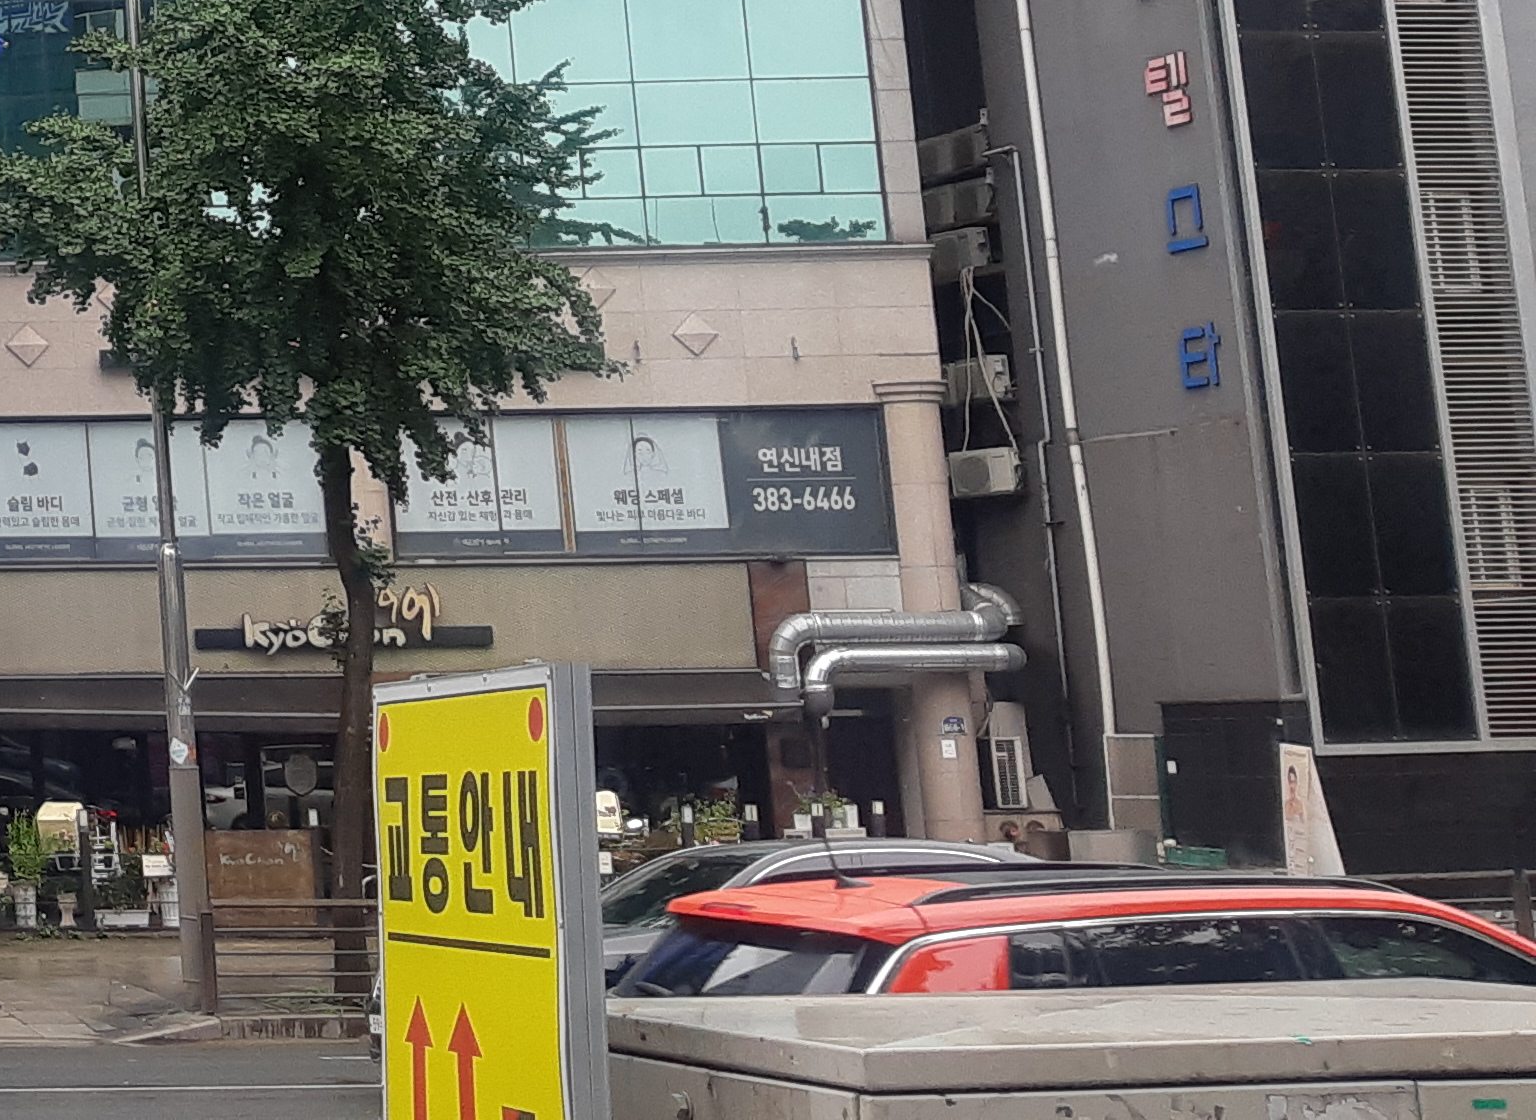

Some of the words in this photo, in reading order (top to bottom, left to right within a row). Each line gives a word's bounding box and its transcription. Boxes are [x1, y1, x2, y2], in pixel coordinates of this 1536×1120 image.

[757, 446, 843, 473] 연신내점
[6, 495, 33, 513] 슬림
[36, 494, 64, 512] 바디
[500, 488, 528, 505] 관리
[644, 487, 685, 505] 스페셜
[752, 486, 856, 512] 383-6466
[384, 770, 545, 920] 교통안내
